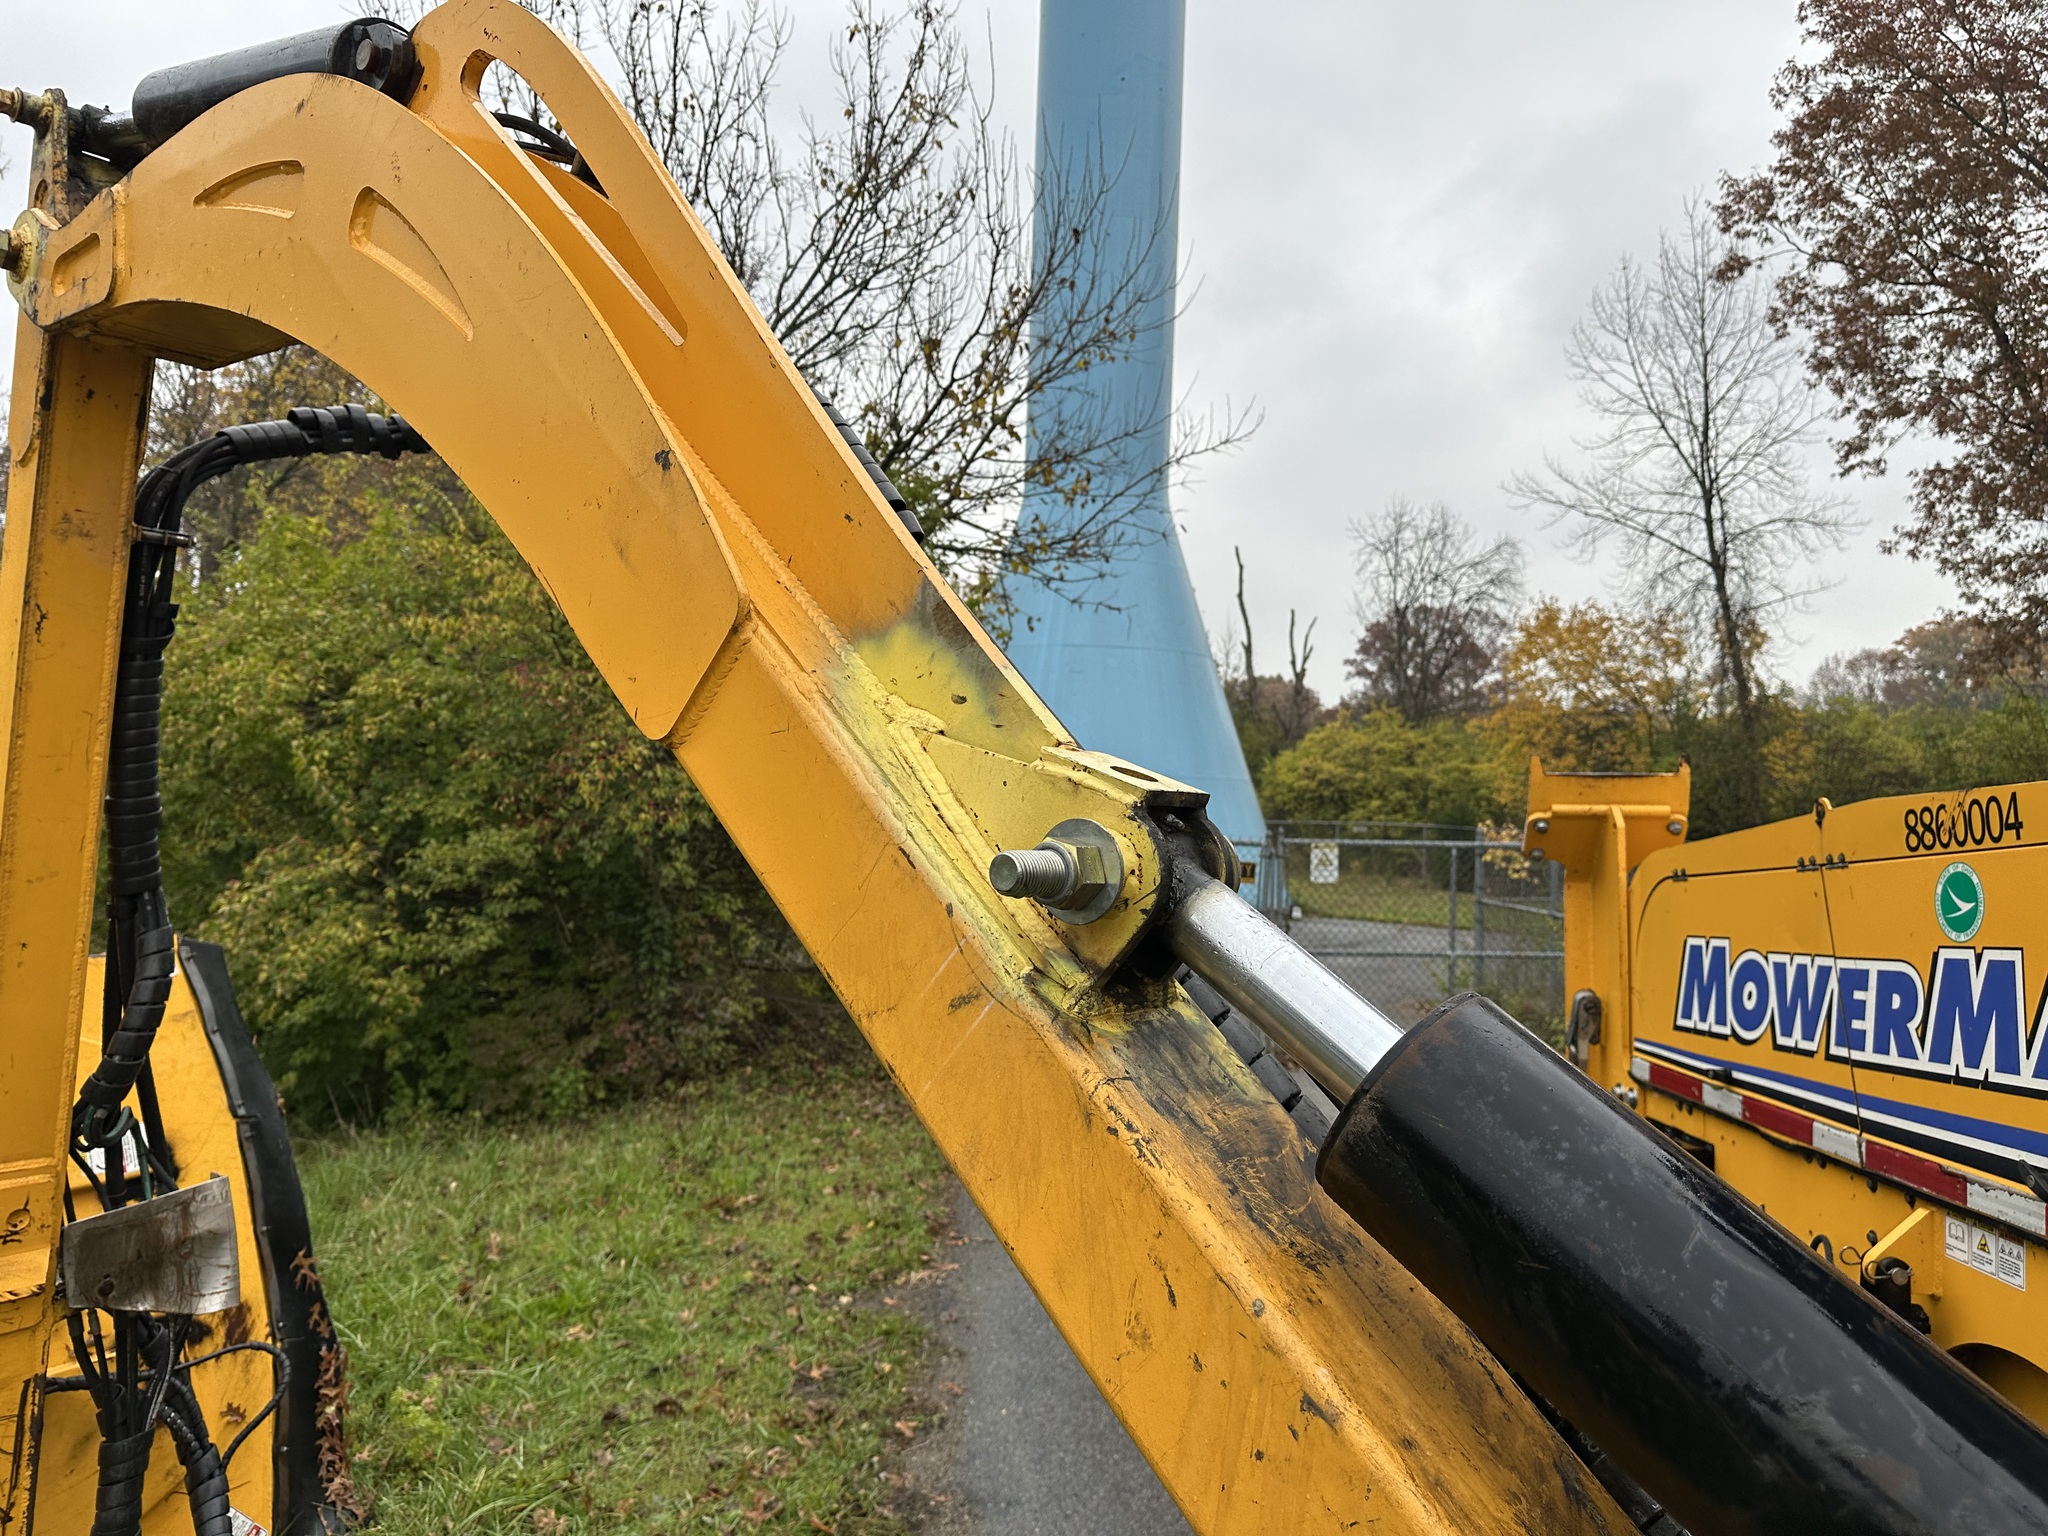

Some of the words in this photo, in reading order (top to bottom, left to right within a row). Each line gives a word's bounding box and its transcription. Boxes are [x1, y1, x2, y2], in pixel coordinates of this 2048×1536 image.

[1904, 791, 2024, 852] 8860004
[1939, 867, 1951, 886] STATE
[1952, 864, 1959, 872] OF
[1961, 864, 1974, 878] OHIO
[1936, 892, 1954, 937] DEPARTMENT
